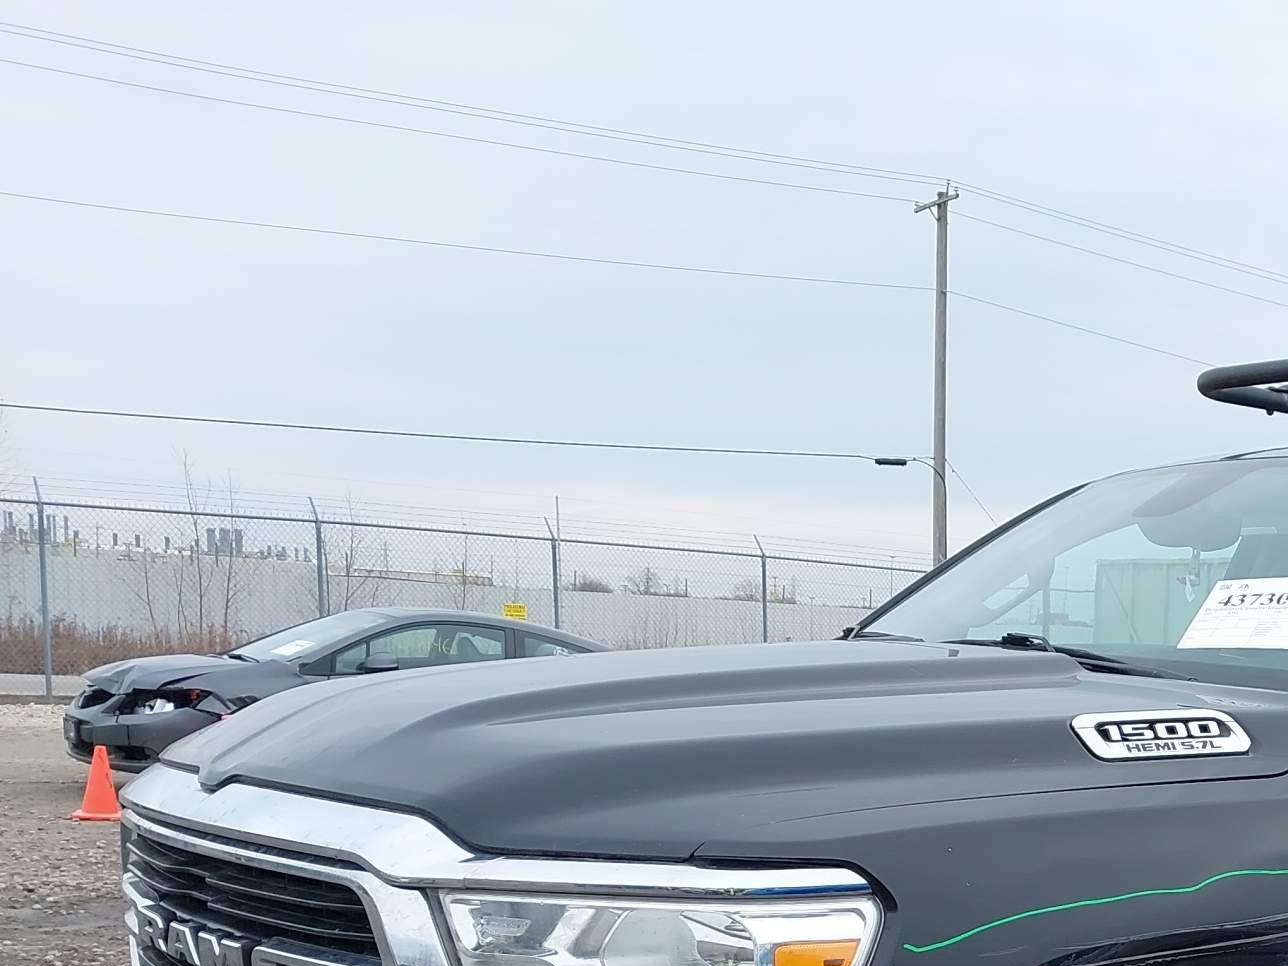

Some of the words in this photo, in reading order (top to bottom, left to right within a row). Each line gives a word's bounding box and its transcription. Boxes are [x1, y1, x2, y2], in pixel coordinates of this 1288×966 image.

[1101, 721, 1220, 741] 1500
[1126, 741, 1177, 753] HEMI
[1181, 740, 1222, 750] 5.7L
